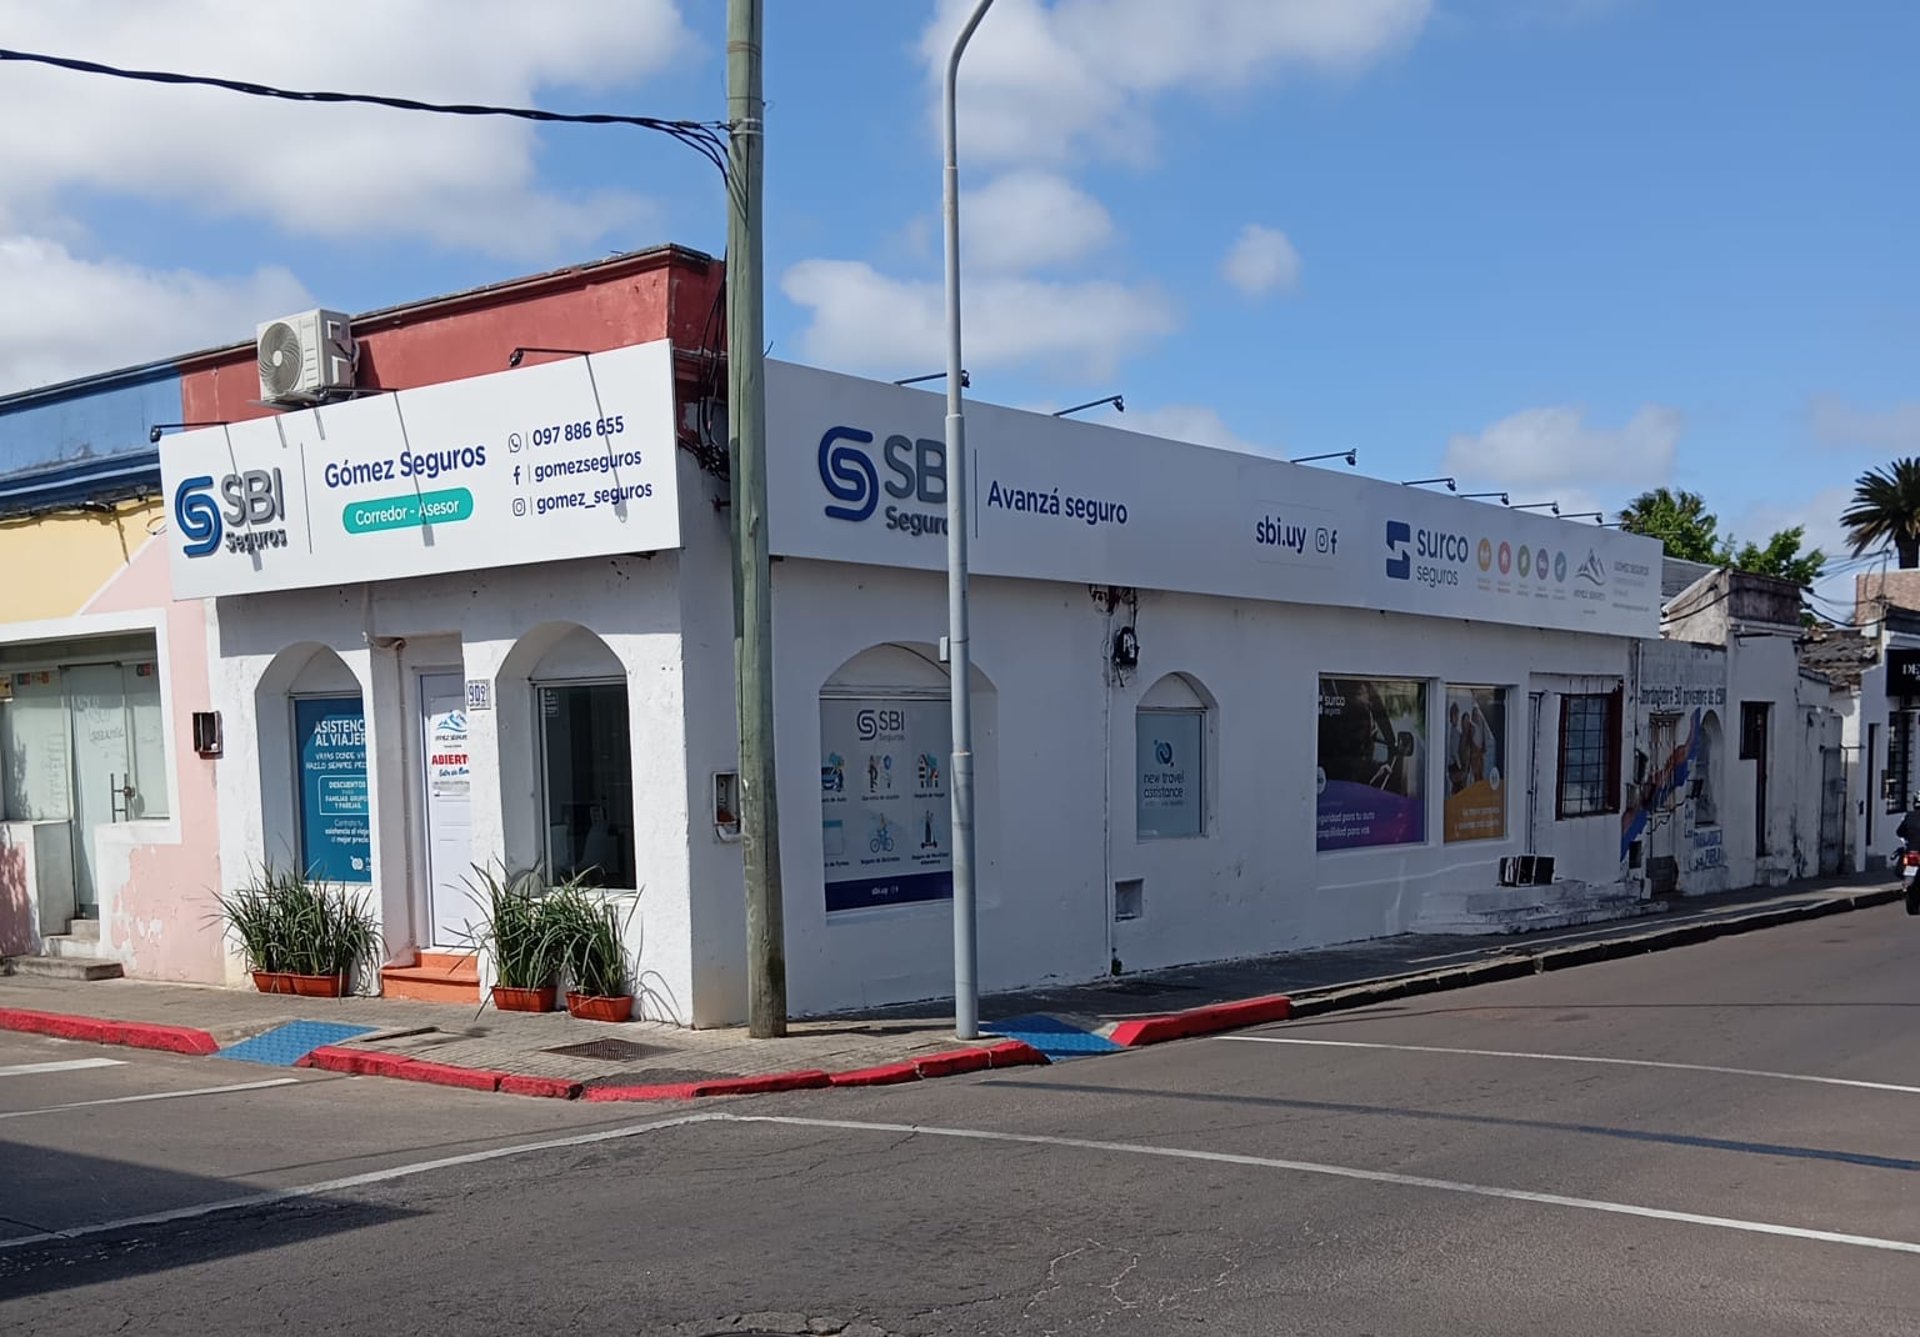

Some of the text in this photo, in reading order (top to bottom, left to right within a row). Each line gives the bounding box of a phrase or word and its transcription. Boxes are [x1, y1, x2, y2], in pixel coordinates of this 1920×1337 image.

[532, 415, 624, 447] 097 886 655
[324, 443, 487, 489] Gómez Seguros
[534, 449, 642, 484] gomezseguros
[884, 434, 948, 504] SB
[220, 467, 285, 527] SBI
[536, 481, 653, 515] gomez_seguros
[987, 479, 1128, 526] Avanzá seguro
[355, 502, 407, 527] Corredor
[418, 499, 460, 523] Asesor
[225, 527, 289, 556] Seguros
[1256, 515, 1307, 554] sbi.uy
[1417, 528, 1469, 563] surco
[1416, 565, 1459, 589] seguros
[469, 685, 486, 702] 902
[1324, 696, 1346, 707] surco
[314, 719, 367, 734] ASISTENC
[879, 710, 905, 731] SBI
[315, 733, 330, 747] AL
[432, 754, 469, 765] ABIERT
[1143, 769, 1185, 784] new travel
